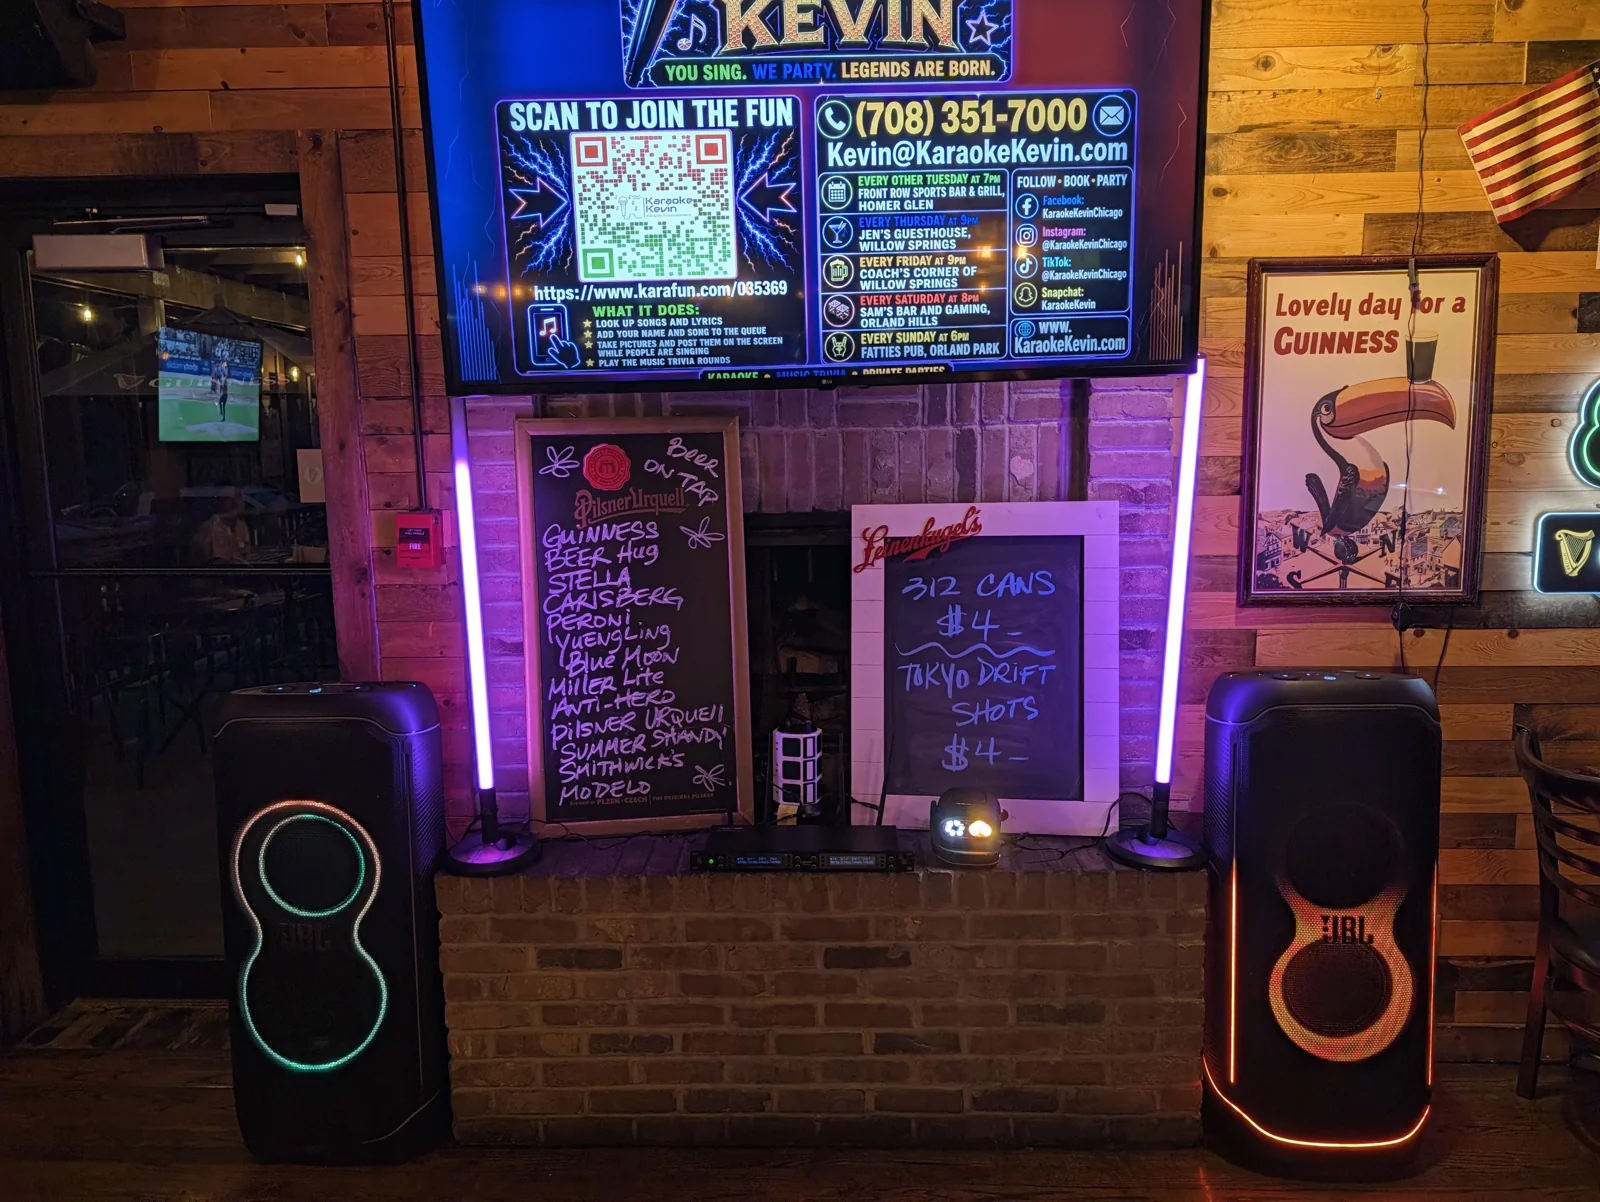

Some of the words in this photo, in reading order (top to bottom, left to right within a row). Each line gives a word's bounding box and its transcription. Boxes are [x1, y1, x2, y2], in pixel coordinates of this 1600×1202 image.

[717, 0, 961, 53] KEVIN
[665, 64, 700, 81] YOU
[703, 63, 747, 81] SING.
[752, 63, 779, 80] WE
[782, 62, 837, 80] PARTY.
[841, 61, 910, 79] LEGENDS
[914, 61, 945, 78] ARE
[949, 60, 995, 77] BORN.
[509, 102, 579, 131] SCAN
[586, 101, 618, 130] TO
[626, 99, 684, 129] JOIN
[692, 99, 739, 128] THE
[746, 98, 793, 127] FUN
[855, 100, 934, 137] (708)
[941, 98, 1088, 135] 351-7000
[827, 137, 1128, 168] Kevin@KaraokeKevin.com
[858, 175, 889, 187] EVERY
[892, 174, 924, 186] OTHER
[926, 173, 968, 185] TUESDAY
[971, 175, 980, 184] AT
[983, 173, 1001, 184] 7PM
[1017, 175, 1057, 189] FOLLOW
[1063, 174, 1091, 188] BOOK
[1096, 174, 1128, 187] PARTY
[858, 187, 888, 199] FRONT
[890, 187, 910, 199] ROW
[913, 187, 947, 198] SPORTS
[949, 186, 966, 197] BAR
[969, 186, 976, 197] &
[977, 185, 1005, 198] GRILL,
[645, 196, 693, 205] Karaoke
[858, 200, 901, 211] HOMER
[904, 200, 934, 210] GLEN
[1042, 194, 1085, 206] Facebook:
[1042, 207, 1123, 219] KaraokeKevinChicago
[859, 216, 891, 228] EVERY
[894, 215, 946, 227] THURSDAY
[948, 217, 957, 225] AT
[960, 214, 979, 225] 9PM
[859, 228, 891, 240] JEN'S
[894, 227, 971, 240] GUESTHOUSE,
[1042, 226, 1087, 239] Instagram:
[859, 240, 906, 252] WILLOW
[908, 239, 957, 250] SPRINGS
[1042, 238, 1128, 251] @KaraokeKevinChicago
[859, 256, 894, 268] EVERY
[896, 255, 932, 267] FRIDAY
[934, 257, 945, 266] AT
[947, 254, 966, 266] 9PM
[1041, 256, 1072, 268] TikTok:
[859, 268, 910, 279] COACH'S
[913, 267, 960, 278] CORNER
[962, 266, 977, 277] OF
[1041, 268, 1127, 282] @KaraokeKevinChicago
[534, 280, 787, 303] https://www.karafun.com/035369
[859, 279, 906, 291] WILLOW
[909, 278, 958, 289] SPRINGS
[859, 295, 892, 306] EVERY
[894, 293, 946, 305] SATURDAY
[948, 295, 957, 304] AT
[961, 292, 980, 303] 8PM
[1041, 286, 1085, 300] Snapchat:
[593, 306, 633, 318] WHAT
[639, 305, 652, 317] IT
[658, 304, 700, 317] DOES:
[860, 306, 893, 318] SAM'S
[896, 305, 919, 317] BAR
[920, 304, 942, 316] AND
[945, 303, 991, 316] GAMING,
[1041, 299, 1096, 311] KaraokeKevin
[1276, 292, 1352, 321] Lovely
[1358, 293, 1402, 320] day
[1410, 290, 1446, 315] or
[1452, 296, 1466, 313] a
[596, 319, 620, 329] LOOK
[622, 318, 635, 328] UP
[637, 318, 667, 328] SONGS
[669, 317, 688, 327] AND
[691, 317, 723, 327] LYRICS
[860, 317, 905, 329] ORLAND
[908, 316, 938, 327] HILLS
[597, 329, 614, 339] ADD
[616, 329, 639, 338] YOUR
[641, 328, 666, 338] NAME
[668, 328, 685, 337] AND
[687, 327, 709, 337] SONG
[711, 327, 722, 336] TO
[723, 327, 739, 336] THE
[741, 326, 767, 336] QUEUE
[860, 333, 893, 345] EVERY
[895, 331, 936, 344] SUNDAY
[938, 333, 948, 343] AT
[950, 330, 969, 342] 6PM
[597, 340, 618, 349] TAKE
[619, 339, 656, 349] PICTURES
[658, 338, 676, 348] AND
[677, 338, 698, 347] POST
[700, 338, 721, 347] THEM
[723, 337, 735, 346] ON
[736, 337, 751, 346] THE
[752, 336, 783, 346] SCREEN
[1014, 334, 1126, 354] KaraokeKevin.com
[1274, 326, 1399, 356] GUINNESS
[597, 349, 624, 358] WHILE
[625, 348, 656, 358] PEOPLE
[657, 347, 674, 357] ARE
[675, 347, 710, 356] SINGING
[861, 345, 901, 359] FATTIES
[904, 344, 927, 359] PUB,
[930, 343, 970, 356] ORLAND
[973, 342, 1000, 355] PARK
[598, 358, 620, 368] PLAY
[621, 358, 638, 367] THE
[639, 357, 666, 367] MUSIC
[667, 357, 696, 366] TRIVIA
[697, 356, 731, 366] ROUNDS
[644, 459, 675, 479] ON
[677, 471, 719, 507] TAP
[574, 489, 632, 530] Pilsner
[629, 487, 689, 517] Urquell
[409, 542, 421, 550] FIRE
[853, 505, 982, 573] Leinenkugel's
[545, 547, 612, 572] BEER
[548, 567, 631, 594] STELLA
[901, 576, 961, 601] 312
[976, 570, 1056, 597] CANS
[898, 661, 969, 699] TOKYO
[952, 695, 1039, 727] SHOTS
[560, 734, 647, 764] SUMMER
[1321, 915, 1374, 945] JBL
